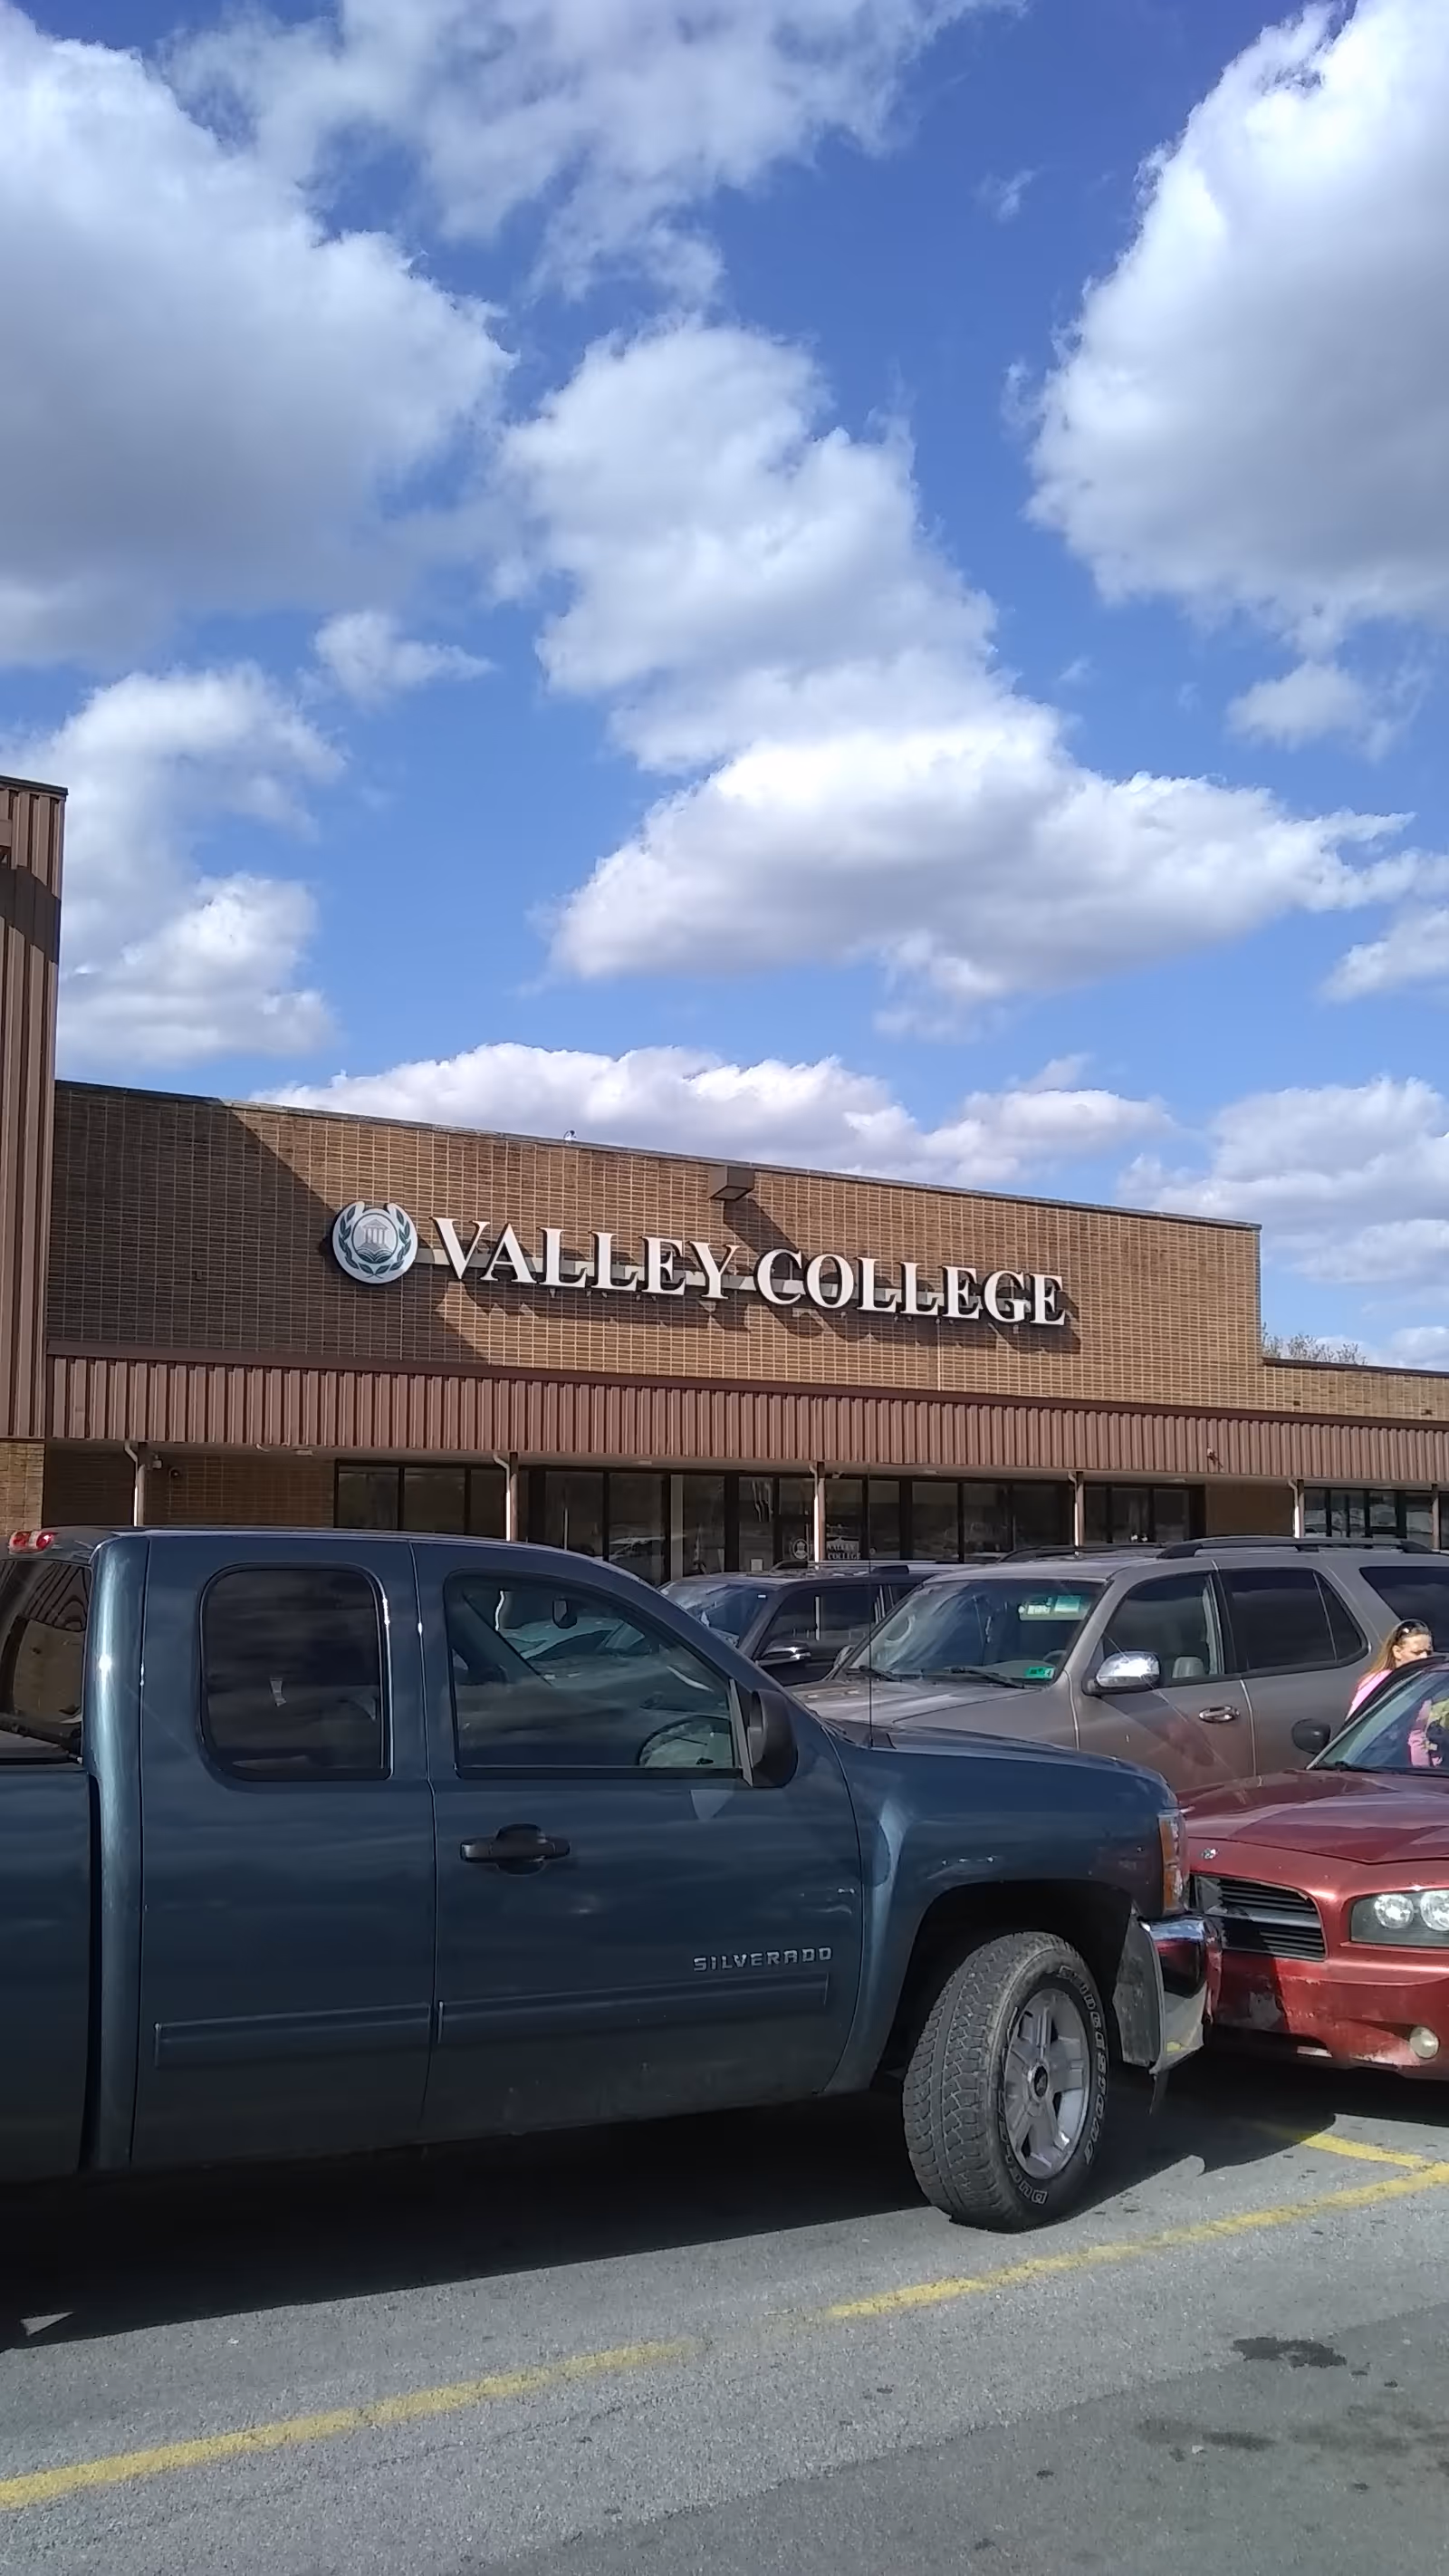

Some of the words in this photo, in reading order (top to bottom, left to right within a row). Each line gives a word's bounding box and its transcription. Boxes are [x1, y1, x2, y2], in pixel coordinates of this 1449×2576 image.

[429, 1216, 742, 1299] VALLEY
[754, 1248, 1067, 1326] COLLEGE
[827, 1552, 861, 1560] COLLEGE
[694, 1946, 833, 1972] SILVERADO
